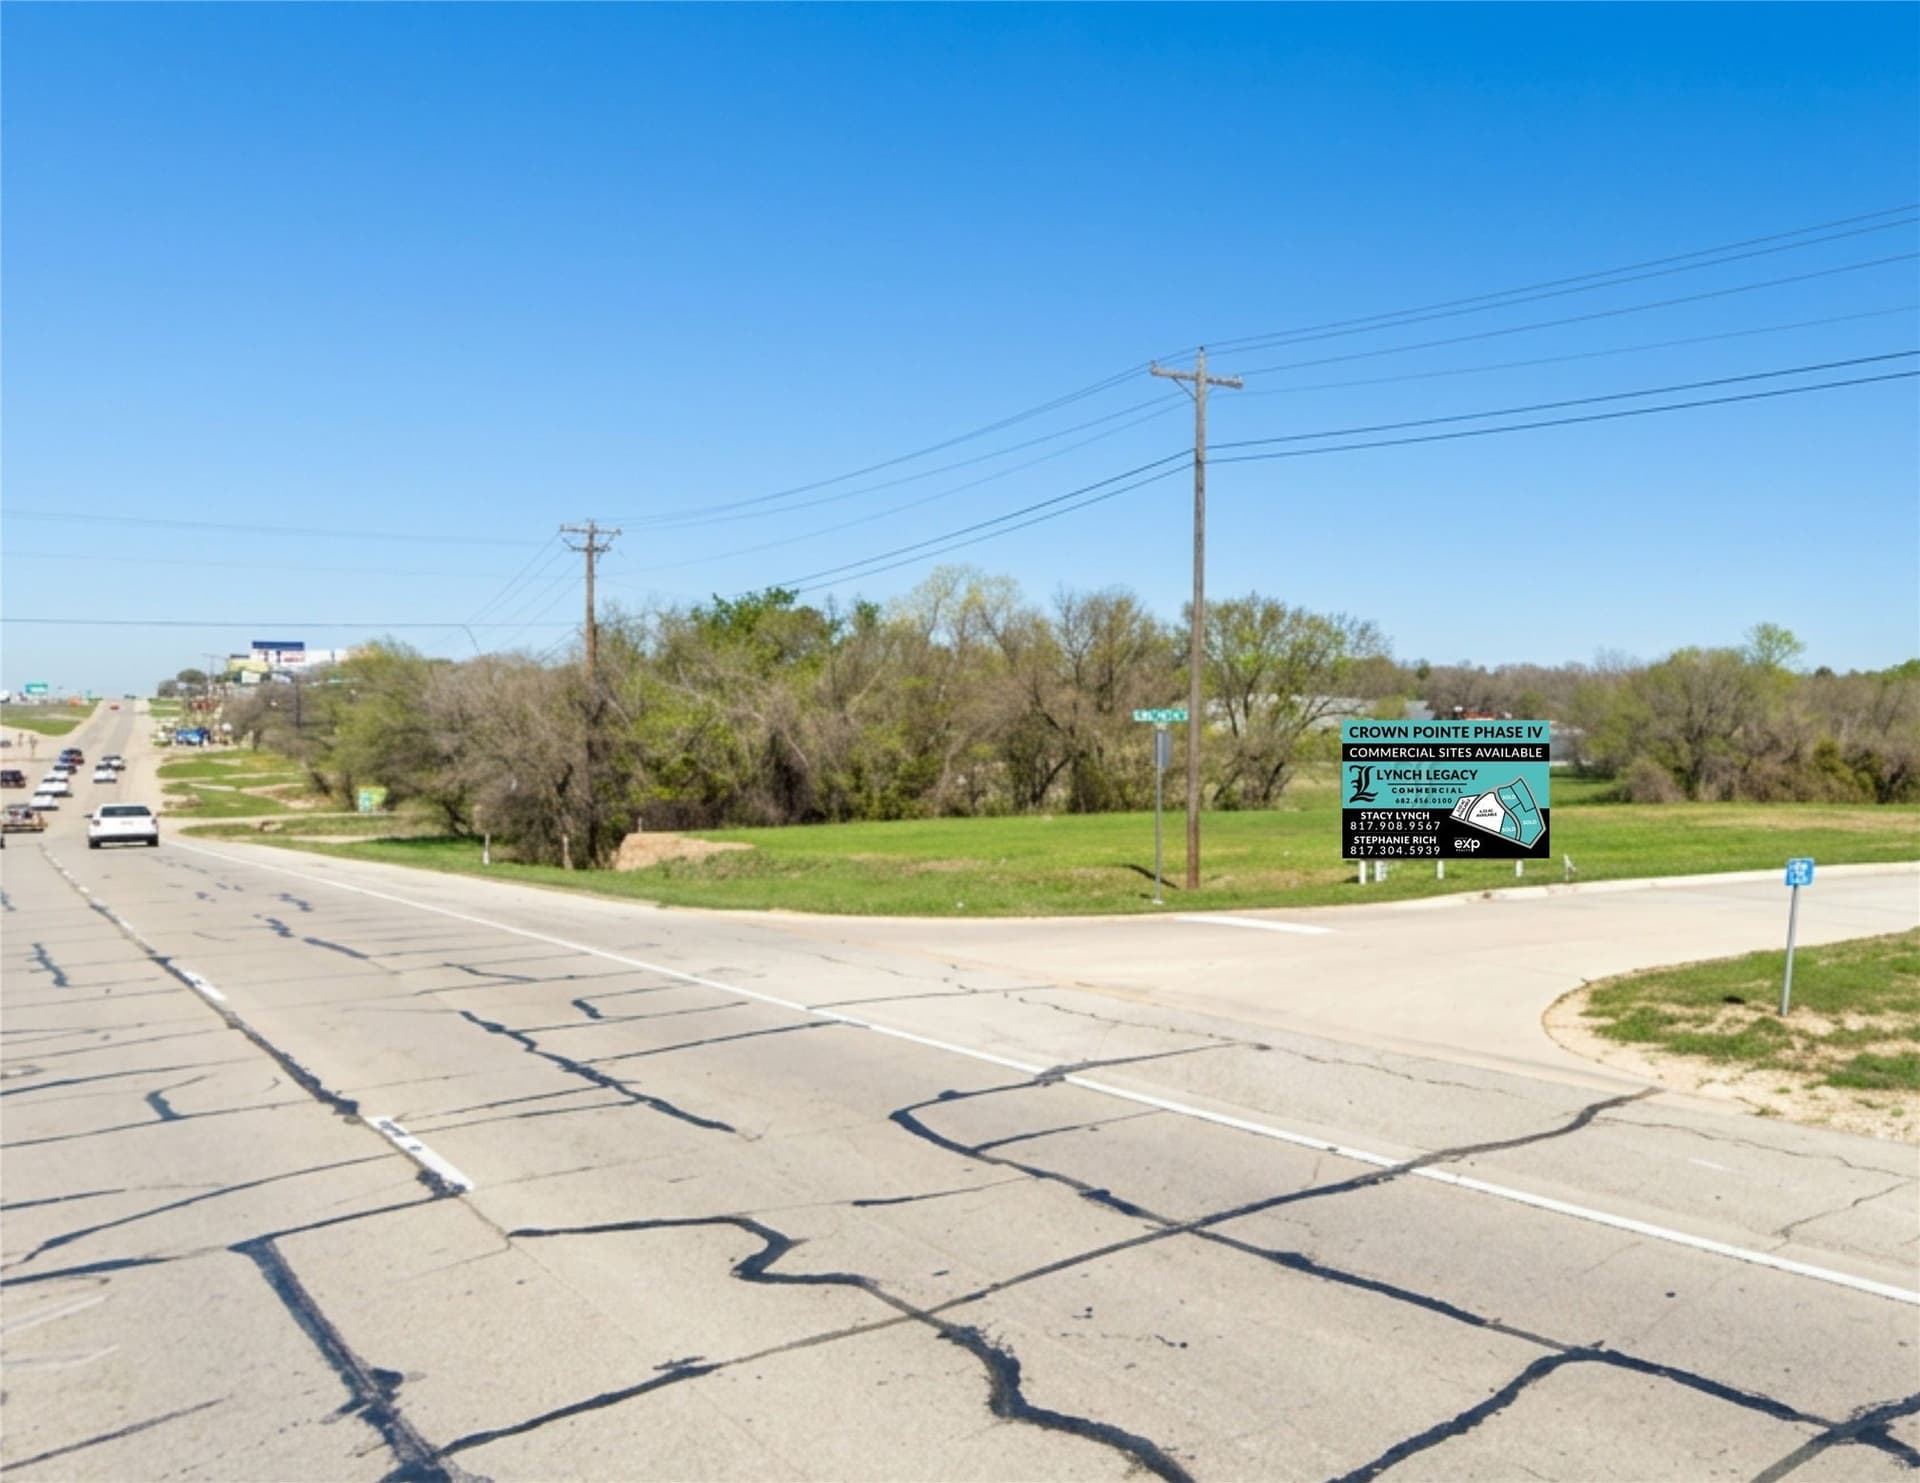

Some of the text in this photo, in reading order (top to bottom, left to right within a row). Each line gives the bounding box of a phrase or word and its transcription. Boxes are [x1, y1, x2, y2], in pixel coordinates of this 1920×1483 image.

[1349, 726, 1543, 738] CROWN POINTE PHASE IV
[1349, 747, 1542, 758] COMMERCIAL SITES AVAILABLE
[1377, 770, 1478, 780] LYNCH LEGACY
[1361, 812, 1430, 820] STACY LYNCH
[1350, 821, 1440, 831] 817.908.9567
[1354, 836, 1437, 844] STEPHANIE RICH
[1350, 846, 1440, 856] 817.304.5939
